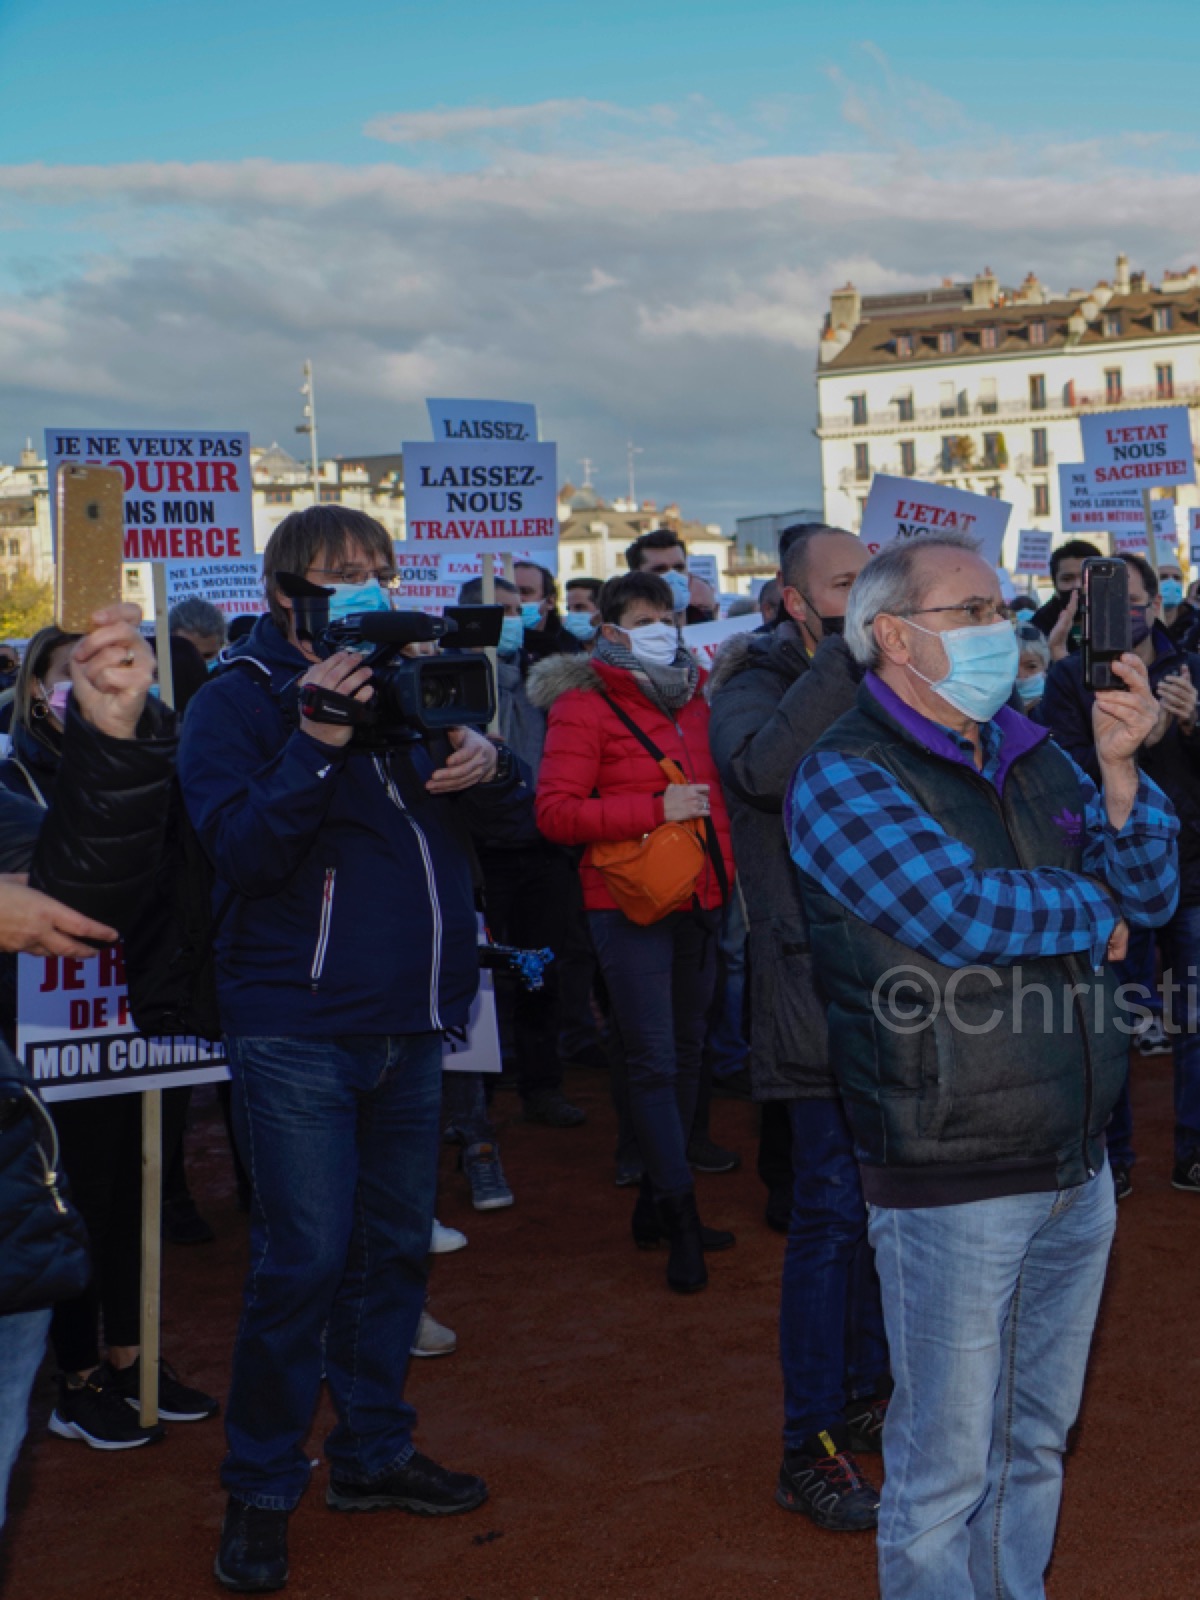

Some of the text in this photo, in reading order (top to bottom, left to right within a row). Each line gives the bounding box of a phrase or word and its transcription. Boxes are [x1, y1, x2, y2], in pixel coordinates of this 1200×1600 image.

[443, 420, 530, 441] LAISSEZ-
[1105, 424, 1168, 444] L'ETAT
[54, 436, 242, 456] JE NE VEUX PAS
[1113, 442, 1167, 460] NOUS
[420, 465, 543, 487] LAISSEZ-
[1094, 460, 1187, 482] SACRIFIE!
[163, 501, 215, 524] MON
[446, 491, 523, 512] NOUS
[894, 500, 976, 531] L'ETAT
[410, 518, 555, 540] TRAVAILLER!
[170, 564, 257, 580] NE LAISSONS
[174, 576, 257, 592] PAS MOURIR
[40, 956, 85, 992] JE
[70, 997, 108, 1031] DE
[33, 1041, 100, 1081] MON
